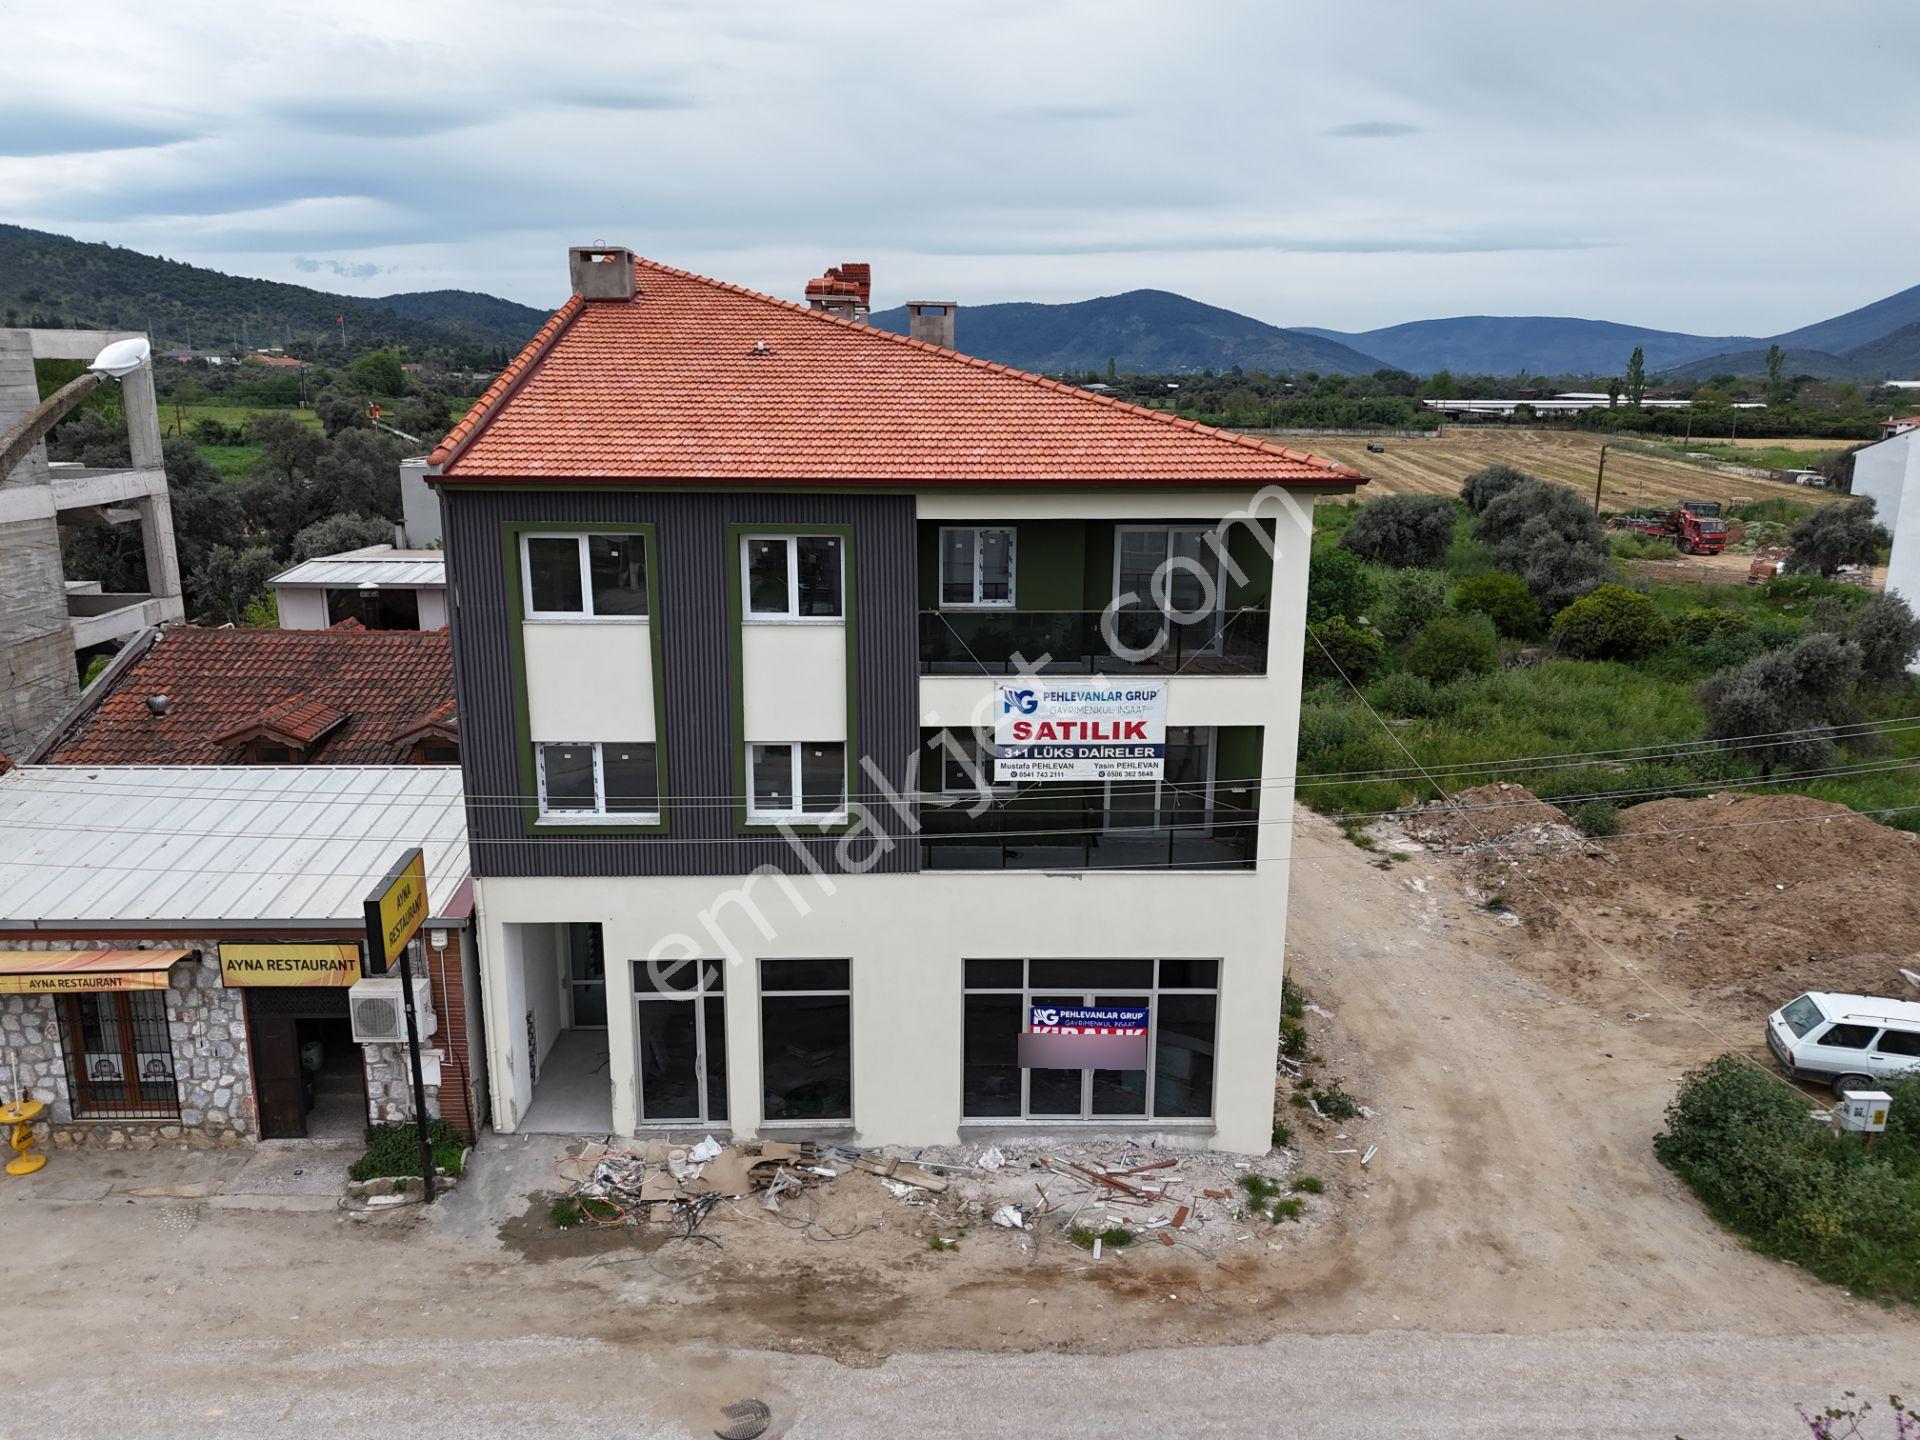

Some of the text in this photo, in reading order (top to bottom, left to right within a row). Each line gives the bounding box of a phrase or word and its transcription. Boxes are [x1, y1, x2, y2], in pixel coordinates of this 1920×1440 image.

[1043, 689, 1157, 702] PEHLEVANLAR GRUP
[1012, 720, 1148, 741] SATILIK
[1004, 745, 1155, 758] 3+1 LÜKS DAİRELER
[1000, 762, 1074, 770] Mustafa PEHLEVAN
[1093, 762, 1159, 770] Yasin PEHLEVAN
[396, 882, 411, 910] AYNA
[389, 892, 422, 946] RESTAURANT
[226, 958, 356, 971] AYNA RESTAURANT
[28, 977, 123, 989] AYNA RESTAURANT
[1060, 1010, 1143, 1020] PEHLEVANLAR GRUP
